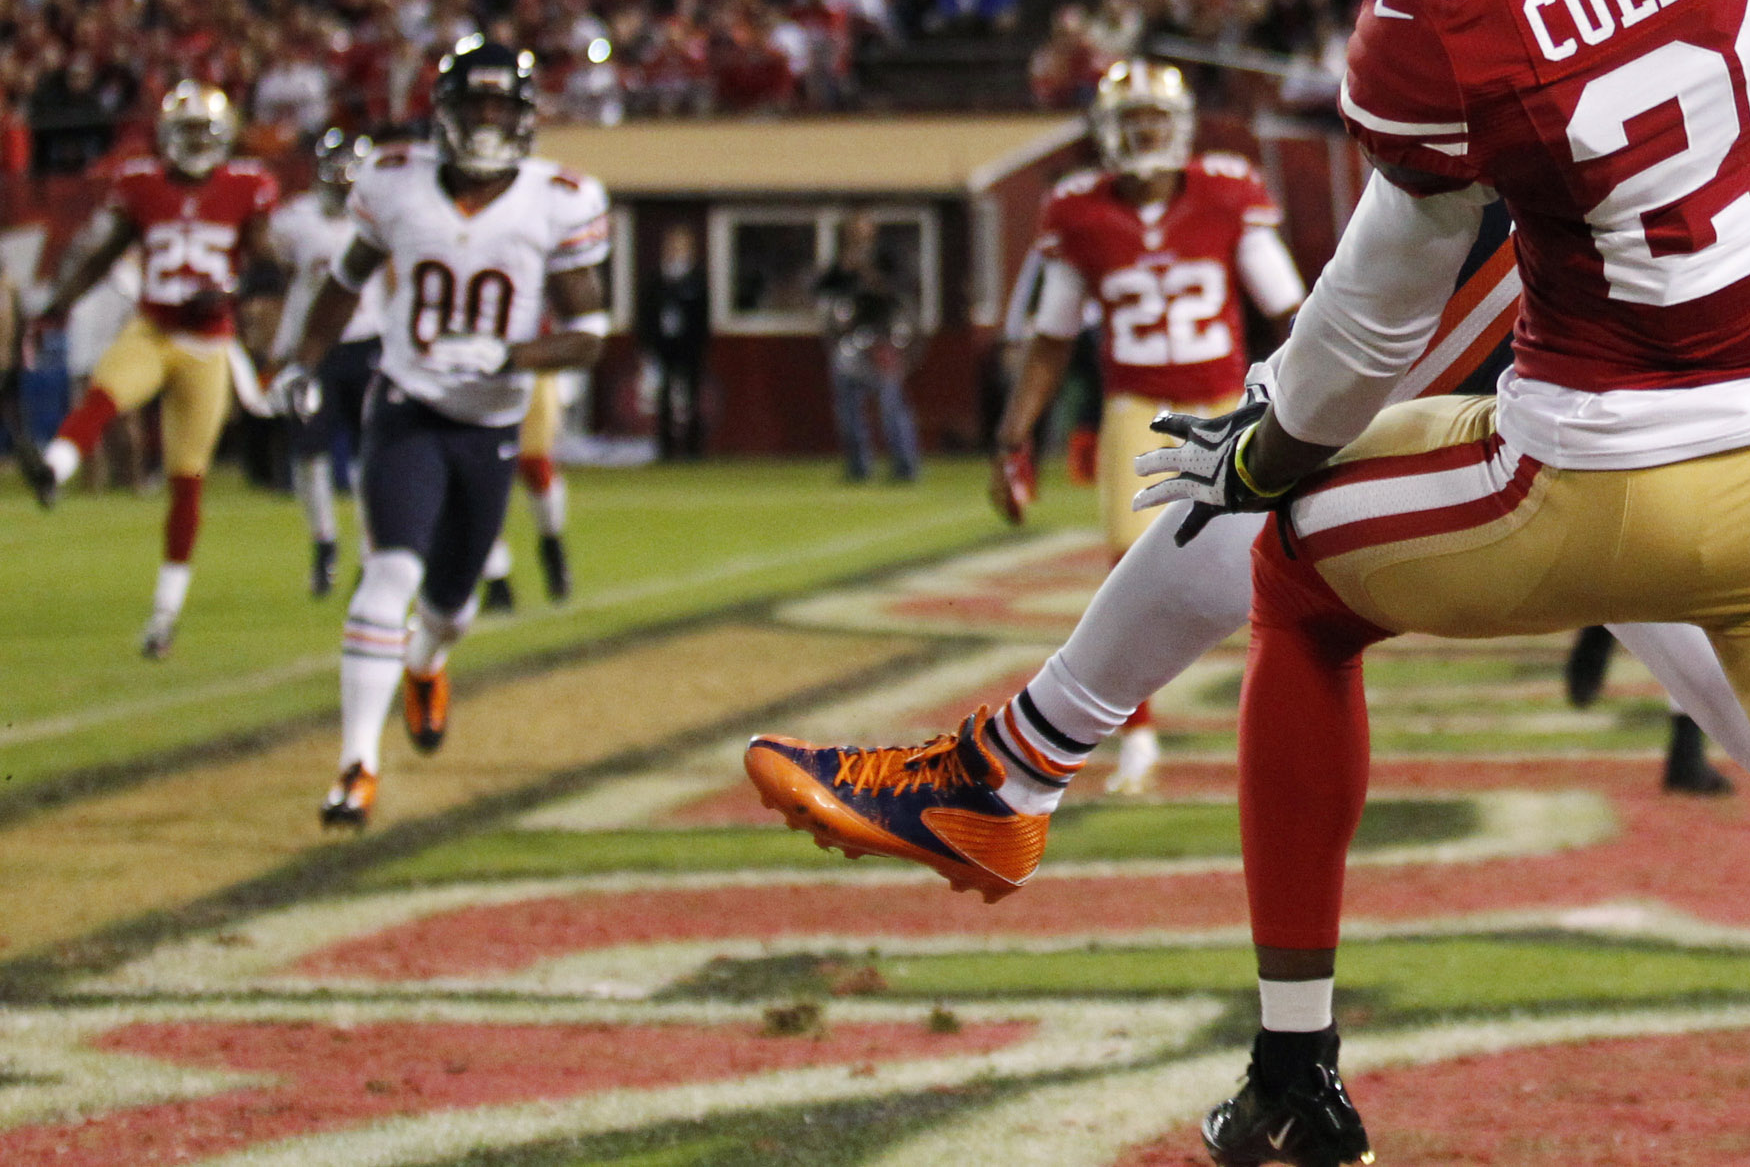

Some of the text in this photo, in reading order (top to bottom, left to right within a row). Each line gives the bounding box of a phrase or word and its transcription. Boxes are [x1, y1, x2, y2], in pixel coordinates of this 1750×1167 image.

[146, 221, 239, 306] 25
[412, 259, 515, 355] 80
[1101, 258, 1233, 366] 22
